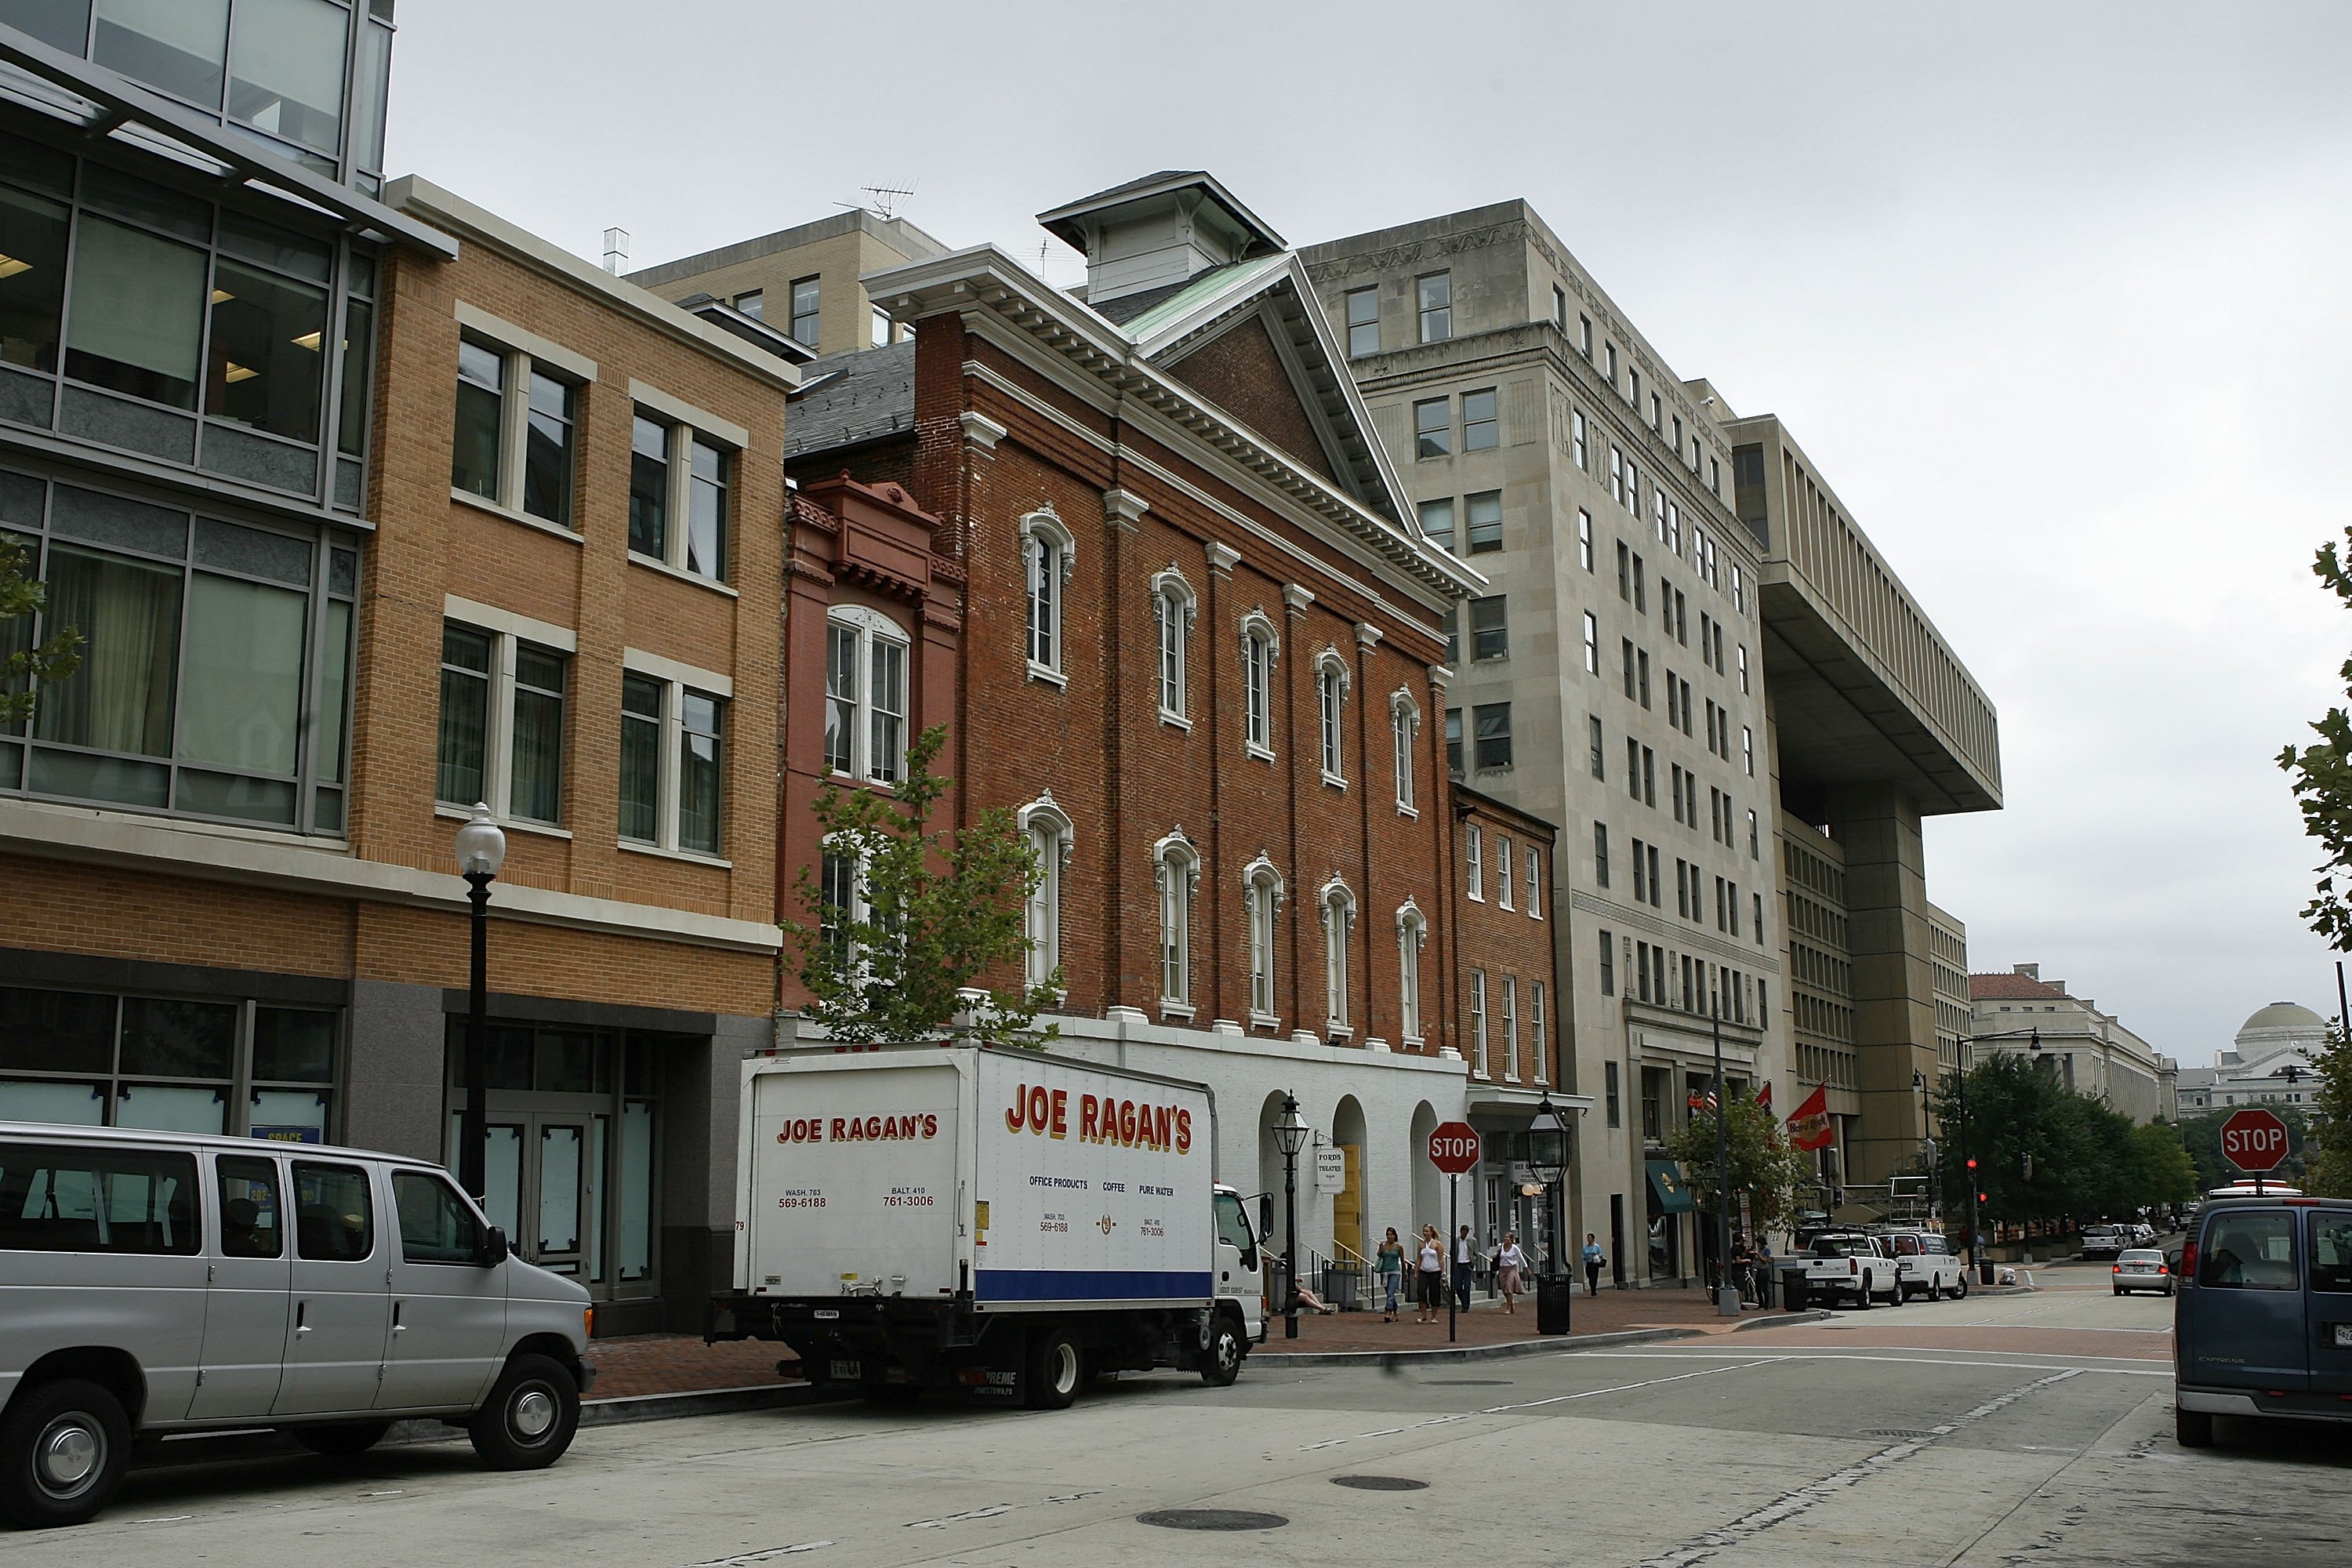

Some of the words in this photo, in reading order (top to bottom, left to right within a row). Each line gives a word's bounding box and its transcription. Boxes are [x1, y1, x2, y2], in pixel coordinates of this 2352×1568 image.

[1005, 1083, 1067, 1140] JOE
[1080, 1093, 1192, 1155] RAGAN'S
[777, 1118, 822, 1144] JOE
[829, 1112, 938, 1142] RAGAN'S
[268, 1132, 303, 1142] SPACE
[2227, 1128, 2282, 1152] STOP
[1432, 1137, 1476, 1159] STOP
[1029, 1175, 1052, 1187] OFFICE
[1054, 1178, 1088, 1189] PRODUCTS
[1102, 1181, 1125, 1192] COFFEE
[1139, 1185, 1154, 1195] PURE
[1156, 1186, 1174, 1196] WATER
[779, 1197, 826, 1208] 569-6188
[884, 1196, 934, 1207] 761-3006
[735, 1221, 745, 1231] 79
[1040, 1221, 1069, 1232] 569-6188
[1140, 1226, 1164, 1237] 761-3006
